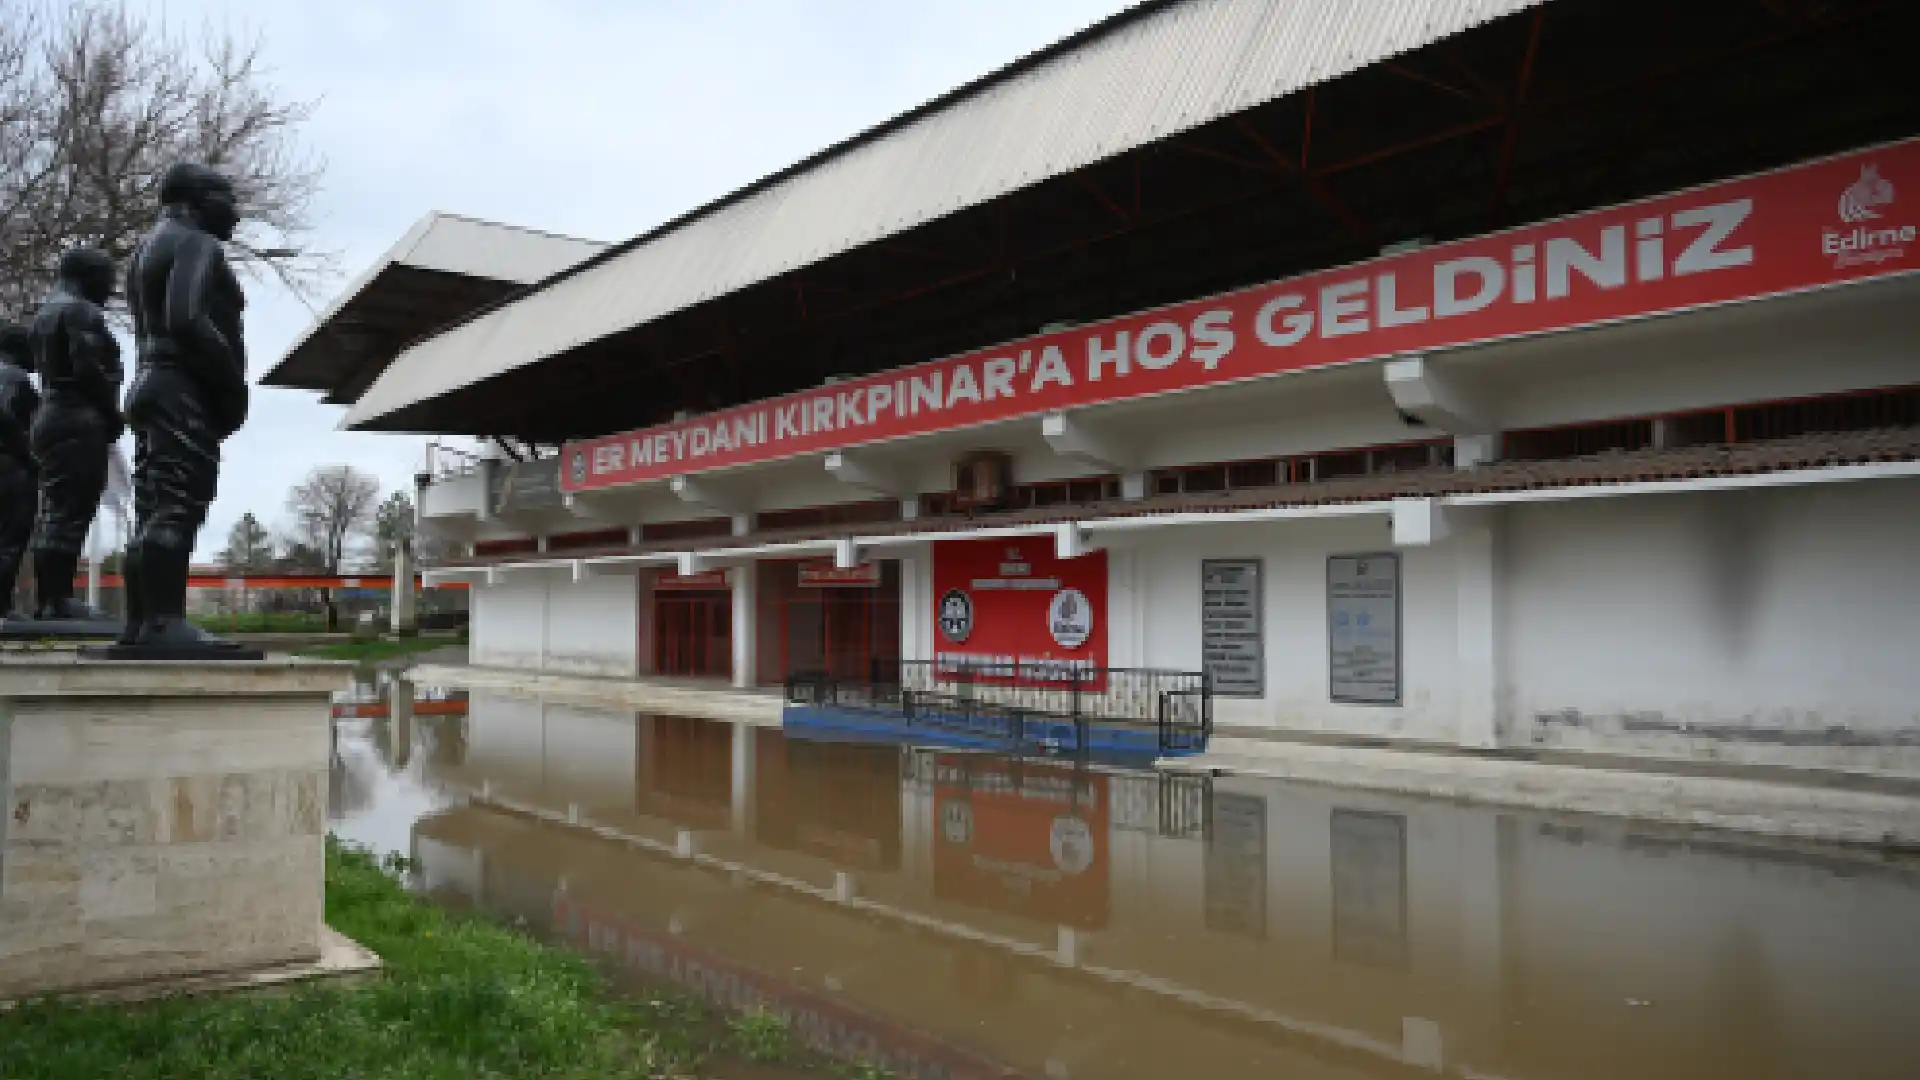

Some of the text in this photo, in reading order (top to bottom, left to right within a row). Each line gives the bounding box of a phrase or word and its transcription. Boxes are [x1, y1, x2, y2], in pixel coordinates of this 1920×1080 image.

[1822, 225, 1916, 255] Edirne
[593, 446, 625, 475] ER
[631, 411, 768, 467] MEYDANI
[775, 345, 1075, 440] KIRKPINAR'A
[1084, 309, 1235, 382] HOŞ
